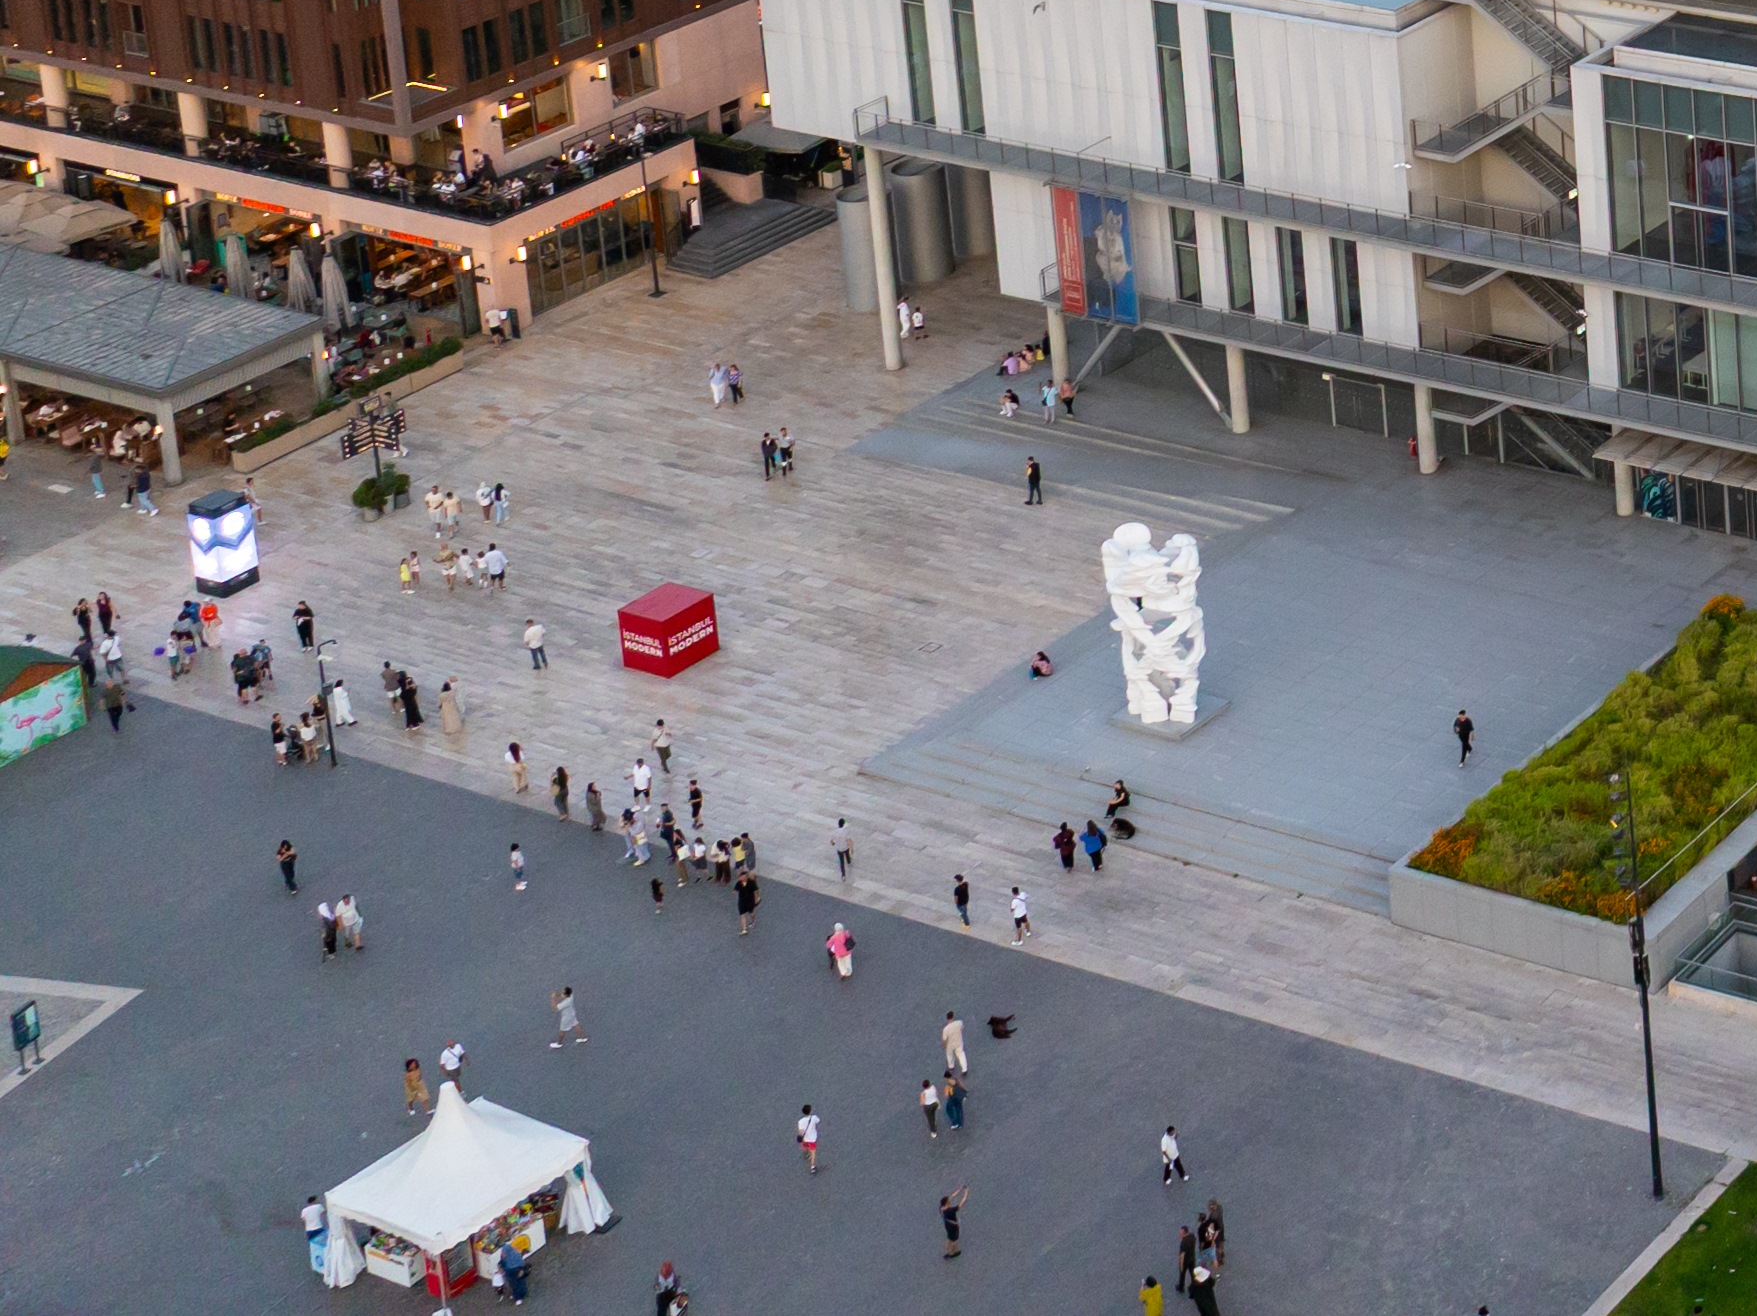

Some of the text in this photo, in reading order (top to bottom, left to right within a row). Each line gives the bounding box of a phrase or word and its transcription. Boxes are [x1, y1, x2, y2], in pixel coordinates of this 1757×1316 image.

[668, 616, 714, 646] İSTANBUL
[669, 625, 714, 656] MODERN
[624, 640, 663, 658] MODERN
